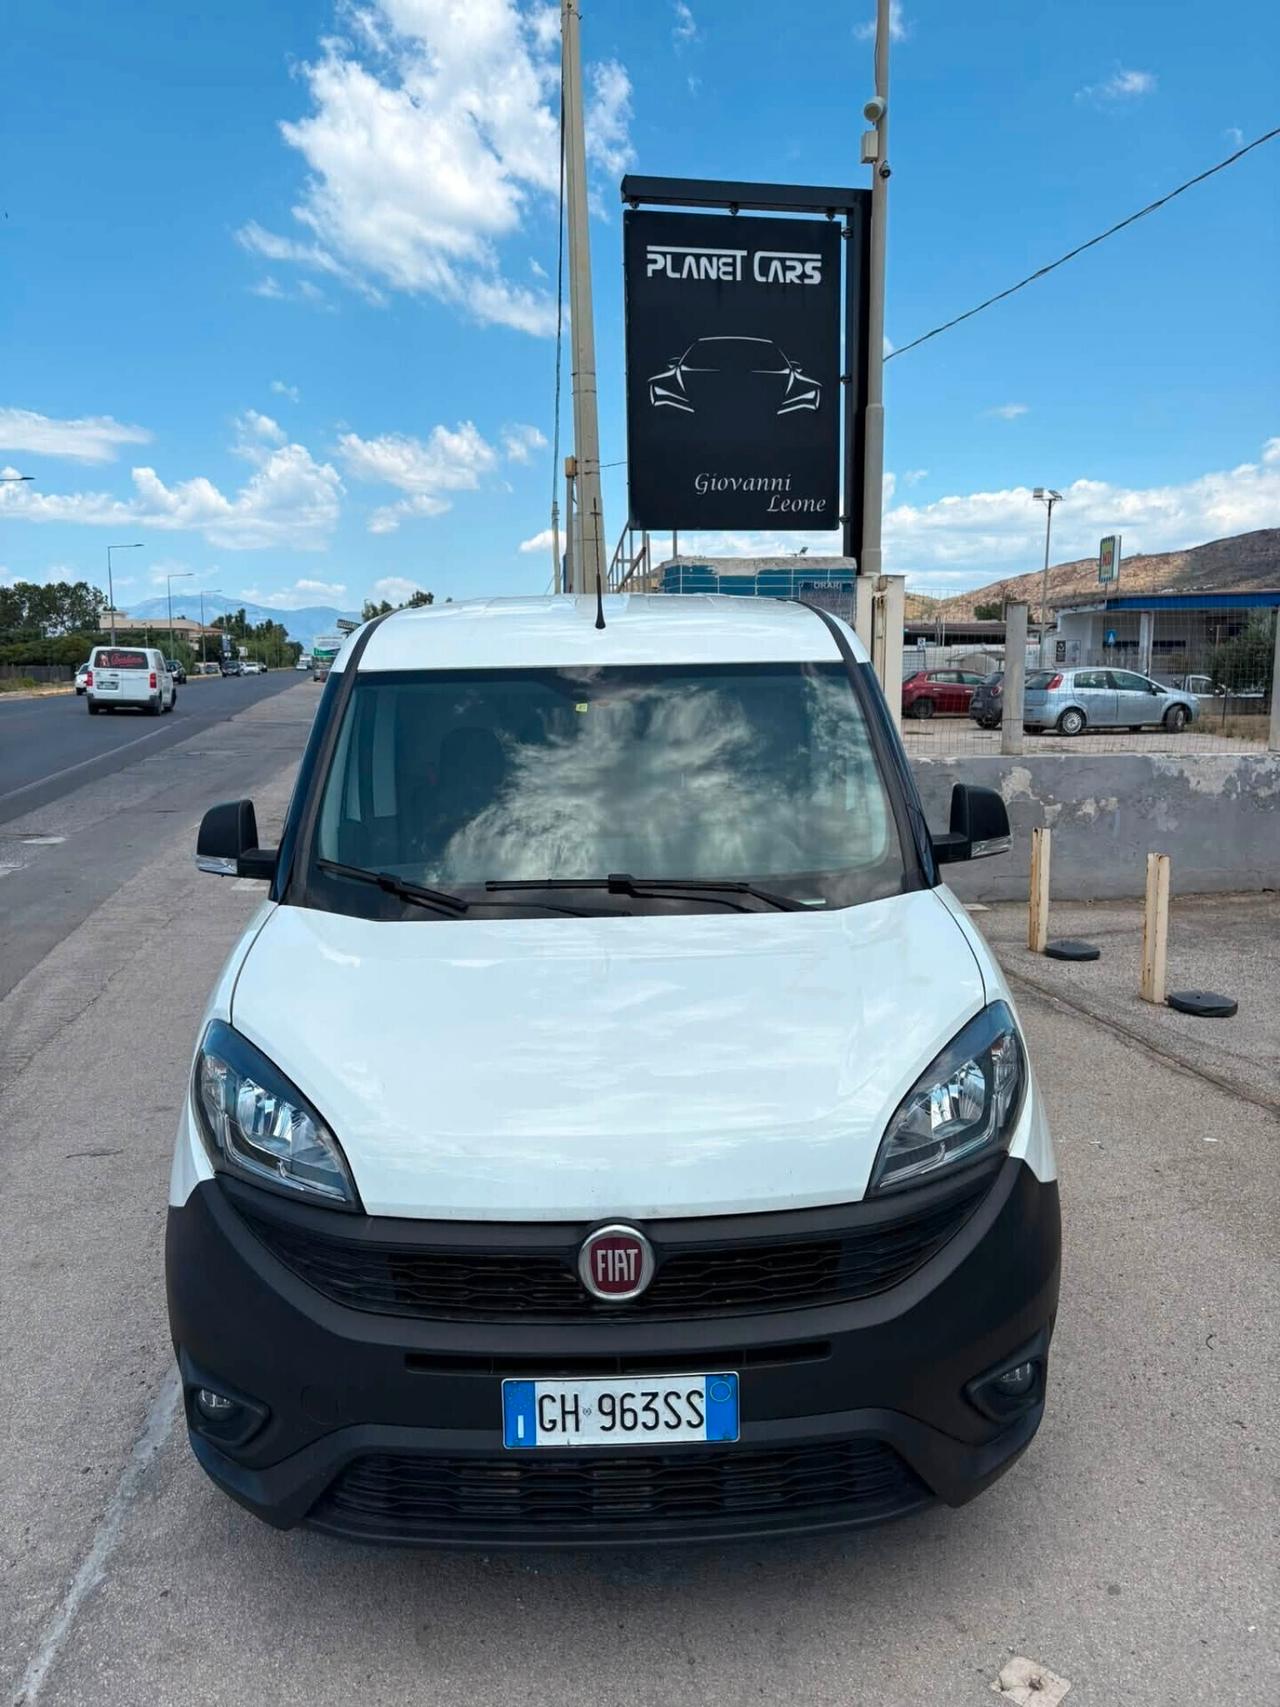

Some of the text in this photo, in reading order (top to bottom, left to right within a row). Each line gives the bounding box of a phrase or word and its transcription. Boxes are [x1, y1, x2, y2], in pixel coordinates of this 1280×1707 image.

[646, 245, 822, 285] PLANET CARS
[694, 473, 792, 495] Giovanni
[766, 495, 826, 513] Leone
[597, 1249, 639, 1282] FIAT
[538, 1389, 705, 1432] GH 963SS
